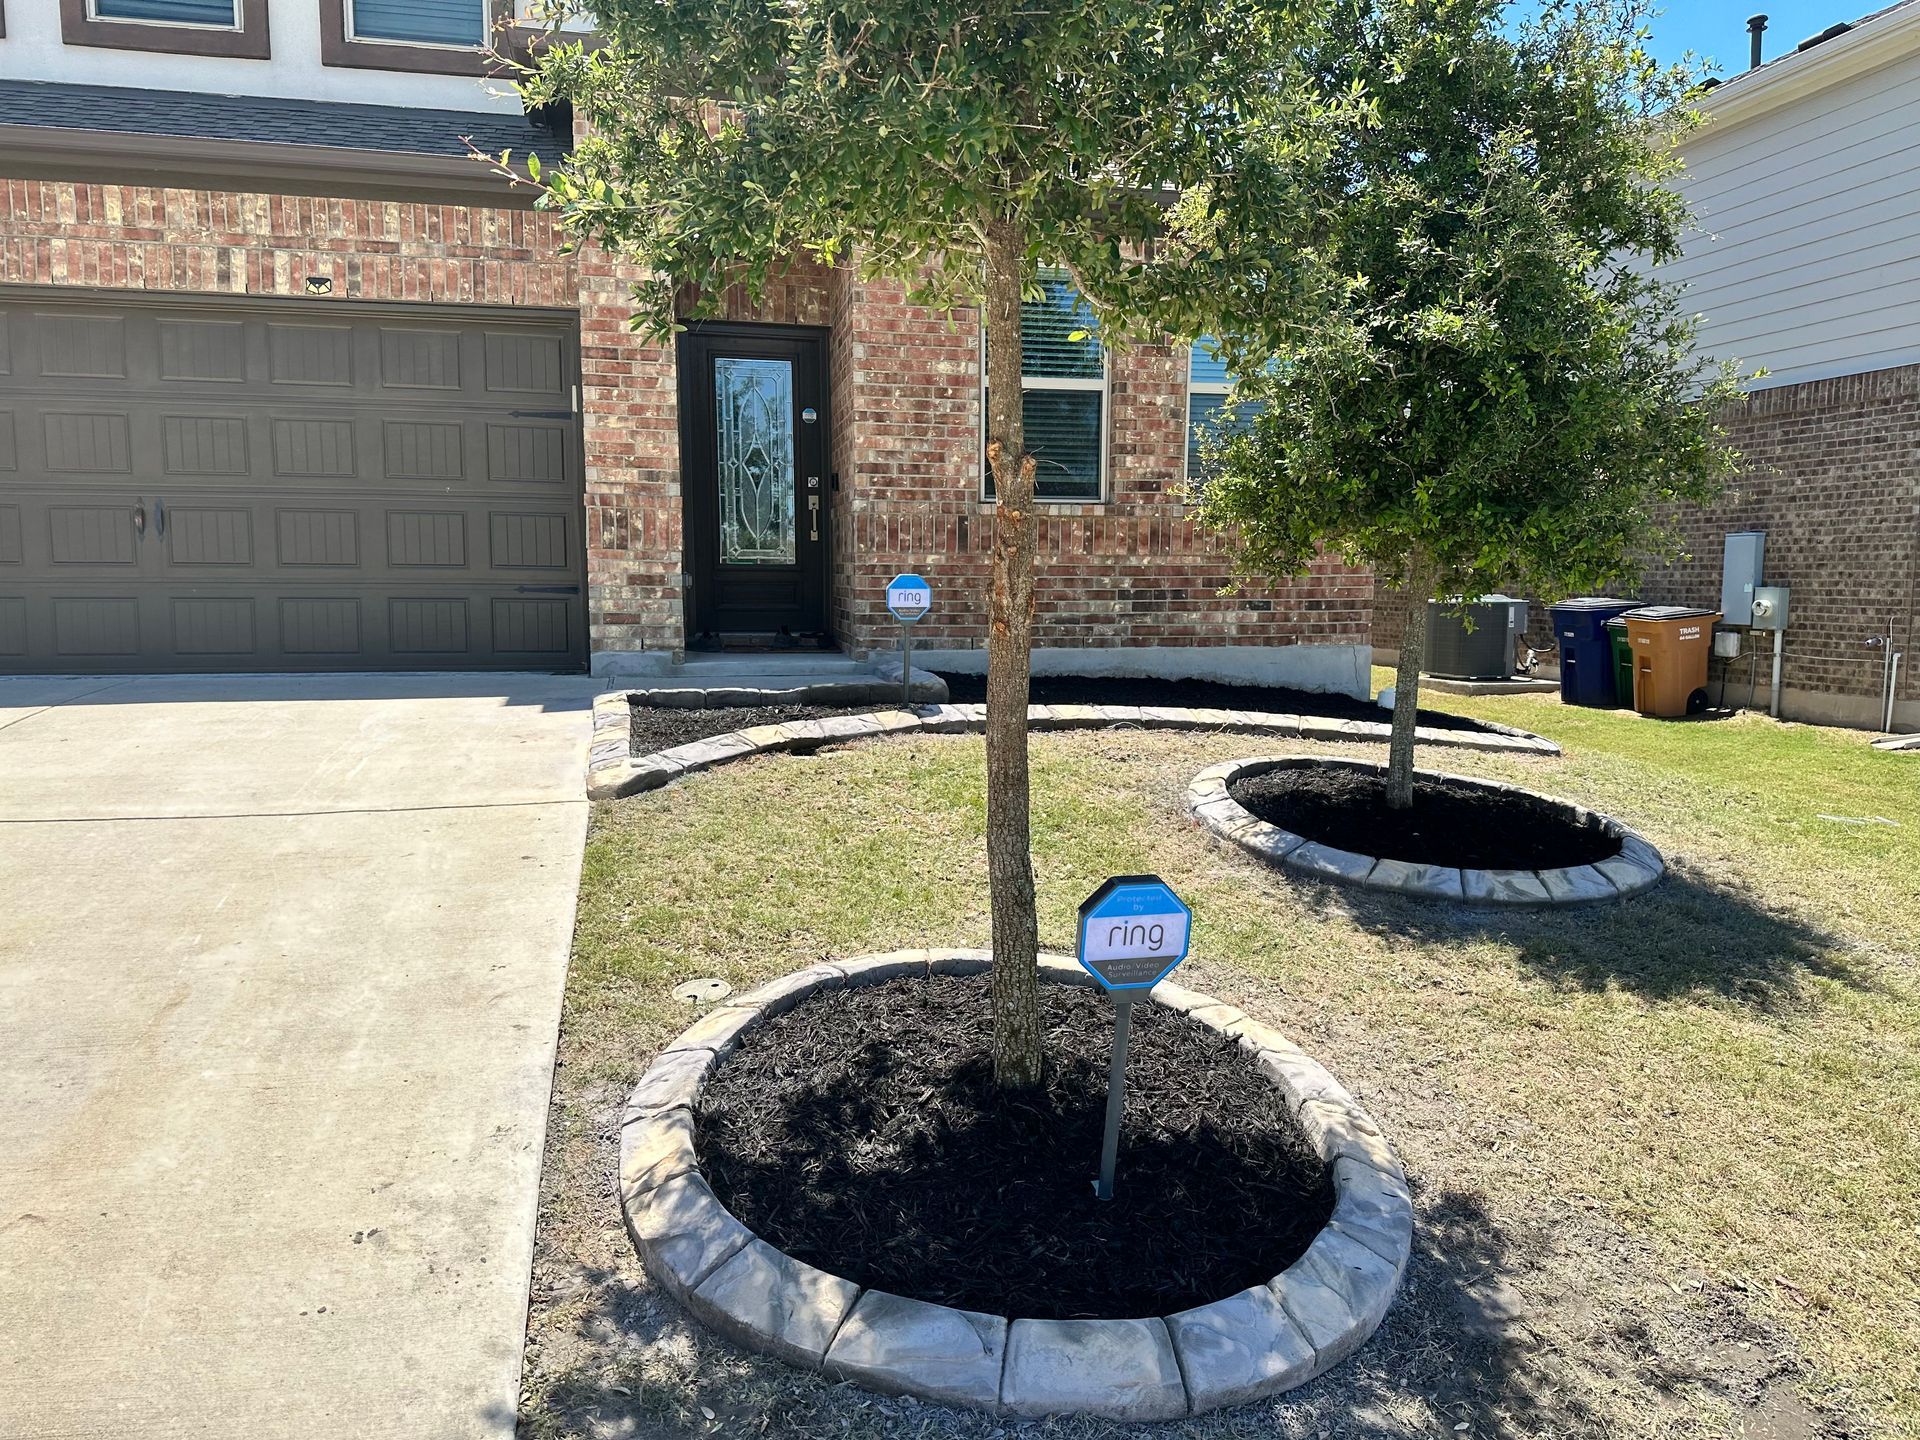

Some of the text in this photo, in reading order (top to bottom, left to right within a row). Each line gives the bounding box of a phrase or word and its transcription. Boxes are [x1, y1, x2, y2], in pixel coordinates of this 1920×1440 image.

[898, 590, 921, 605] ring
[1679, 626, 1700, 635] TRASH
[1109, 920, 1164, 951] ring
[1108, 969, 1157, 978] Surveillance
